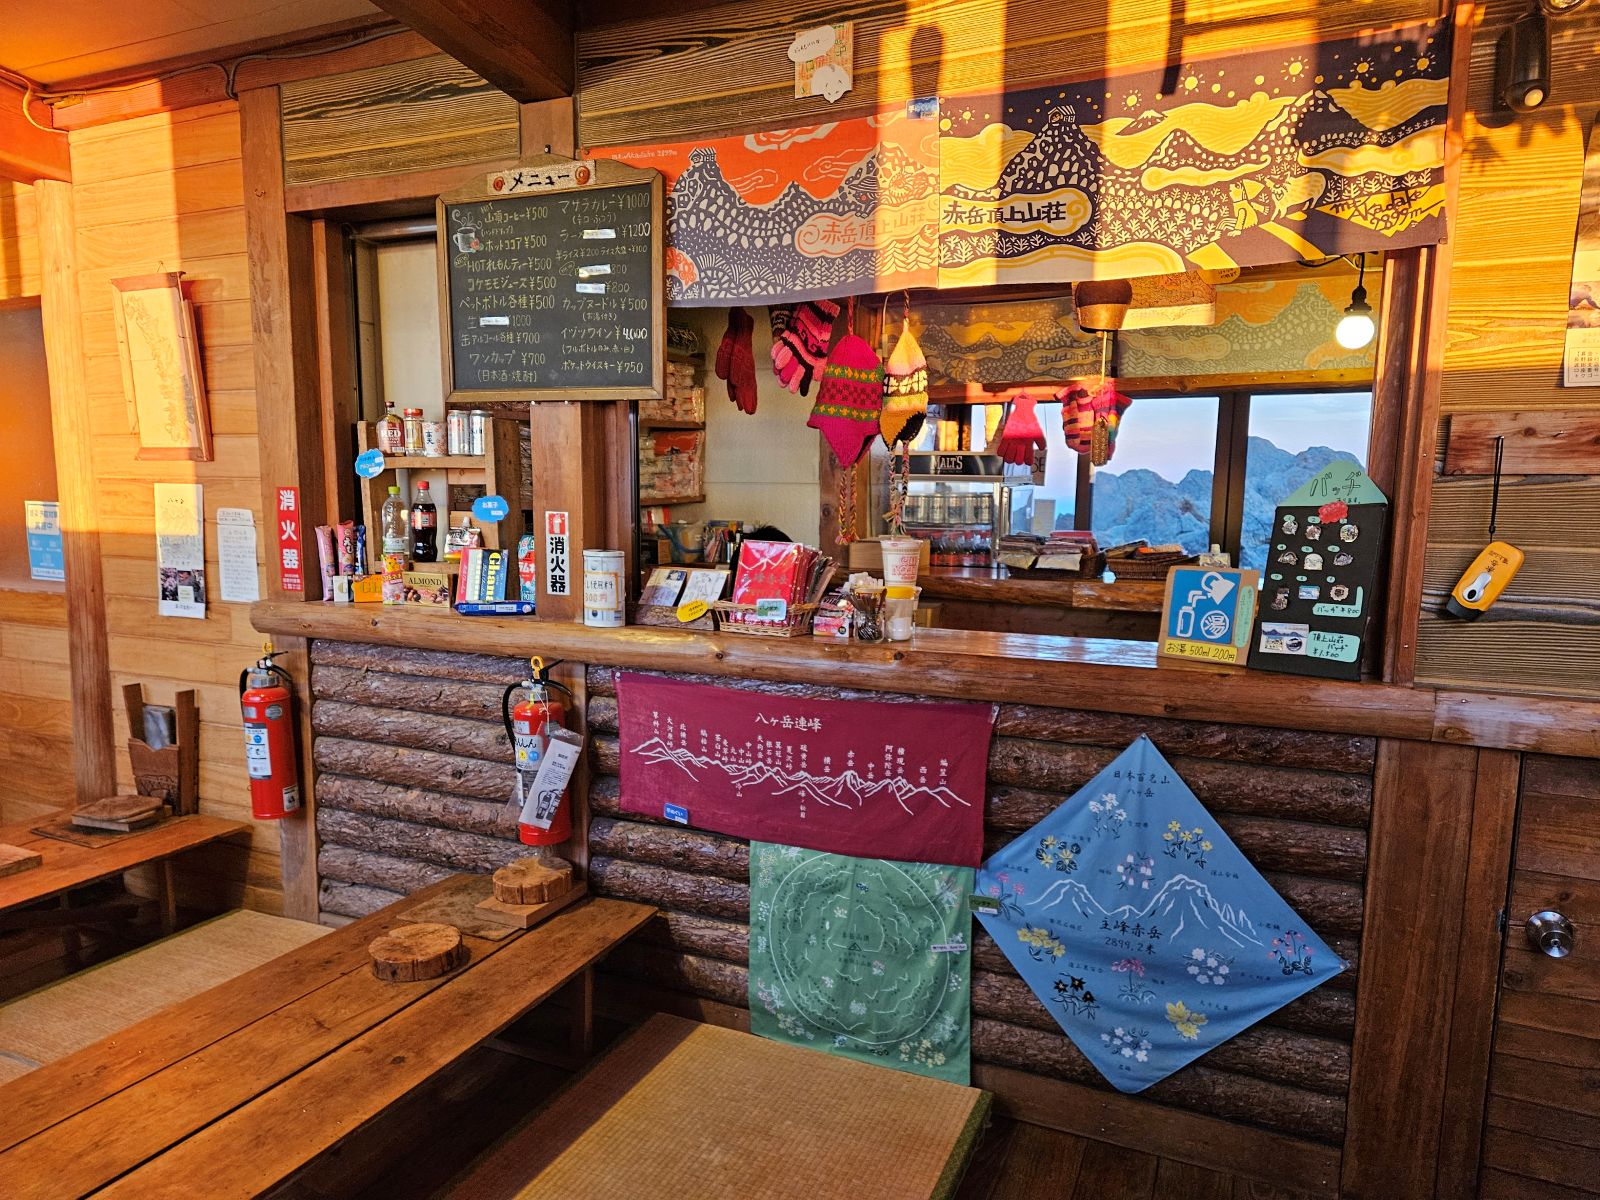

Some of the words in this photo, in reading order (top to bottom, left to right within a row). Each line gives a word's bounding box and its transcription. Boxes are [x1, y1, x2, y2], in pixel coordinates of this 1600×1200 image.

[509, 172, 570, 192] メニュー
[942, 200, 1067, 226] 赤岳頂上山荘
[1349, 187, 1427, 221] Akadake
[820, 206, 927, 246] 赤岳頂上山荘
[280, 489, 300, 569] 消火器
[550, 536, 566, 593] 消火器
[408, 577, 442, 586] ALMOND
[1204, 615, 1226, 636] 湯
[1189, 645, 1210, 657] 500ml
[1212, 648, 1236, 662] 200円
[755, 712, 823, 733] 八ヶ岳連峰
[738, 748, 745, 764] 中山
[745, 741, 753, 765] 中山峠
[867, 762, 875, 779] 中岳
[919, 766, 927, 784] 西岳
[1100, 916, 1163, 940] 主峰赤岳
